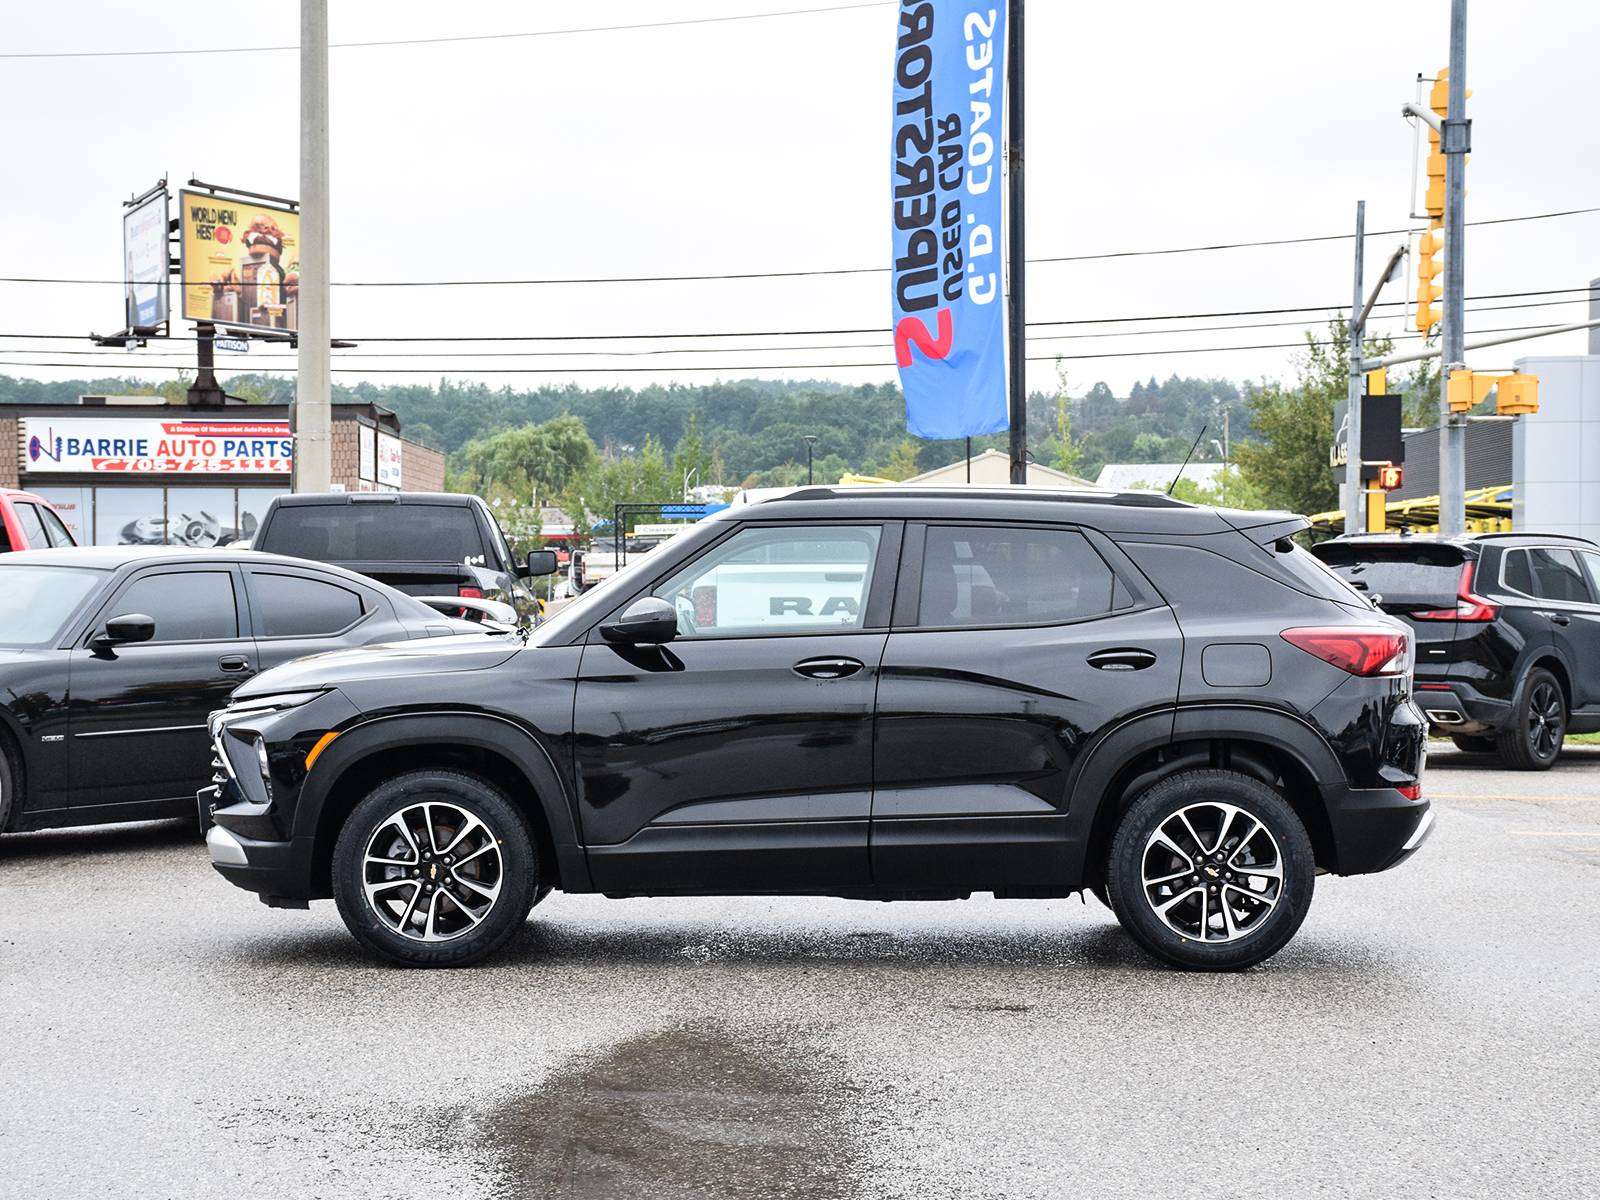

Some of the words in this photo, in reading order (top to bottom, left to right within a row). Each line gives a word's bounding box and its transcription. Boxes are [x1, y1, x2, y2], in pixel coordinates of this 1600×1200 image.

[191, 206, 217, 224] WORLD
[217, 209, 238, 227] MENU
[67, 438, 148, 457] BARRIE
[156, 439, 216, 458] AUTO
[224, 439, 292, 458] PARTS
[769, 597, 860, 616] RA
